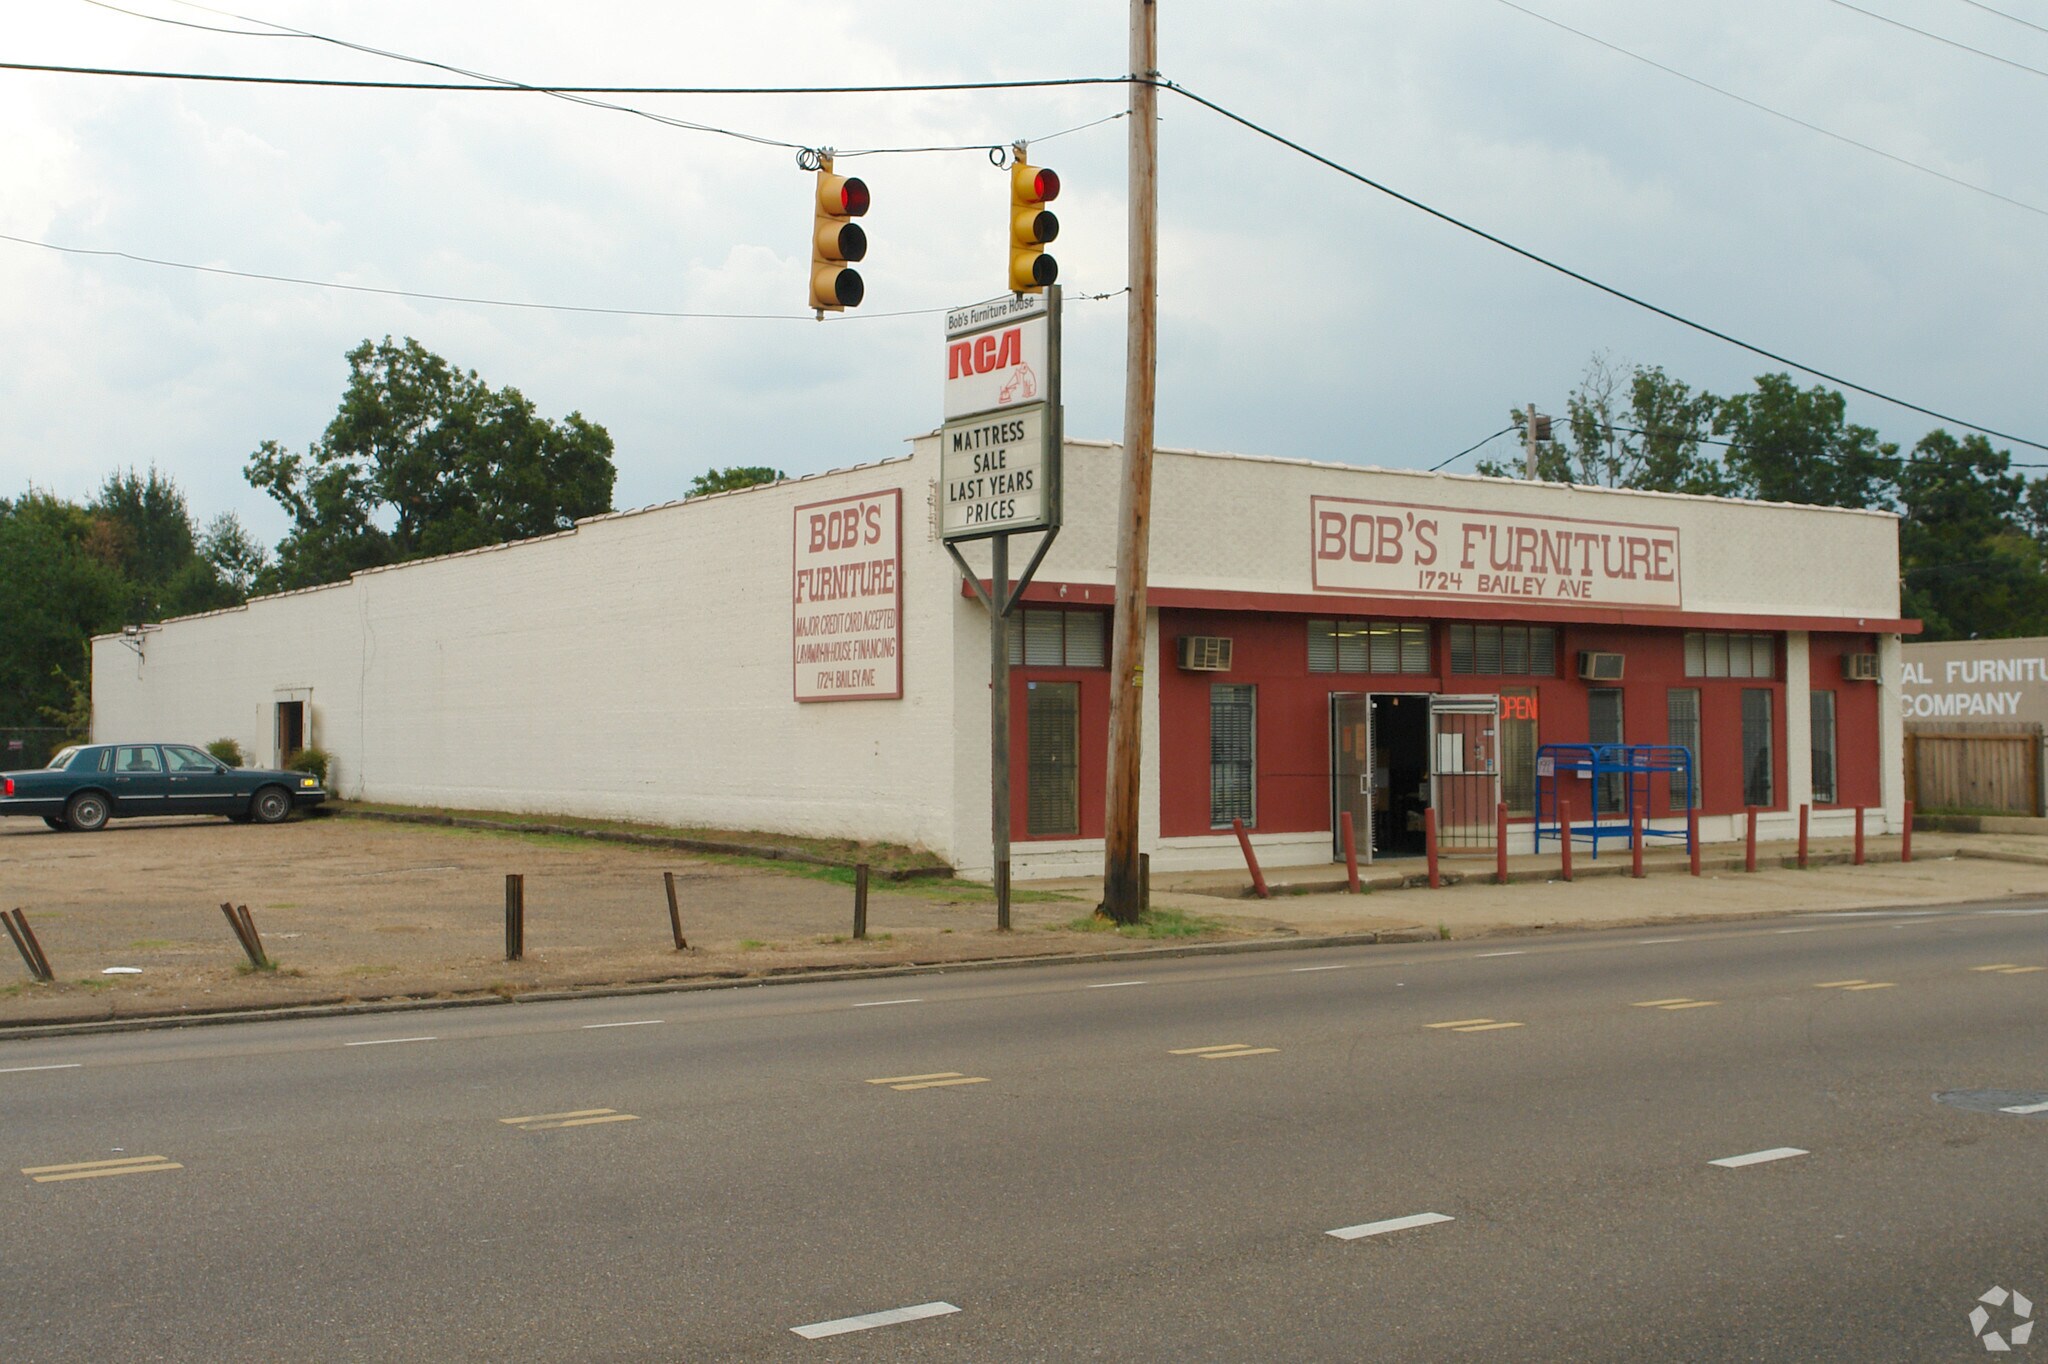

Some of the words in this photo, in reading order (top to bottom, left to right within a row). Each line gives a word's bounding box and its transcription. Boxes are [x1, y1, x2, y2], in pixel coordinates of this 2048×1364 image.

[949, 313, 969, 329] Bob's
[971, 306, 1007, 324] Furniture
[1008, 296, 1034, 314] House
[948, 328, 1021, 380] RCA
[953, 420, 1025, 452] MATTRESS
[973, 449, 1007, 474] SALE
[950, 478, 984, 503] LAST
[989, 470, 1034, 496] YEARS
[966, 499, 1015, 525] PRICES
[809, 502, 881, 553] BOB'S
[1318, 511, 1438, 566] BOB'S
[1460, 523, 1675, 582] FURNITURE
[796, 559, 895, 604] FURNITURE
[1418, 570, 1463, 592] 1724
[1477, 574, 1546, 597] BAILEY
[1557, 579, 1593, 599] AVE
[797, 617, 820, 637] MAJOR
[821, 613, 845, 635] CREDIT
[845, 612, 862, 632] CARD
[863, 608, 895, 631] ACCEPTED
[853, 637, 895, 660] FINANCING
[817, 672, 834, 689] 1724
[836, 669, 861, 688] BAILEY
[861, 669, 875, 687] AVE
[1901, 662, 1933, 684] AL
